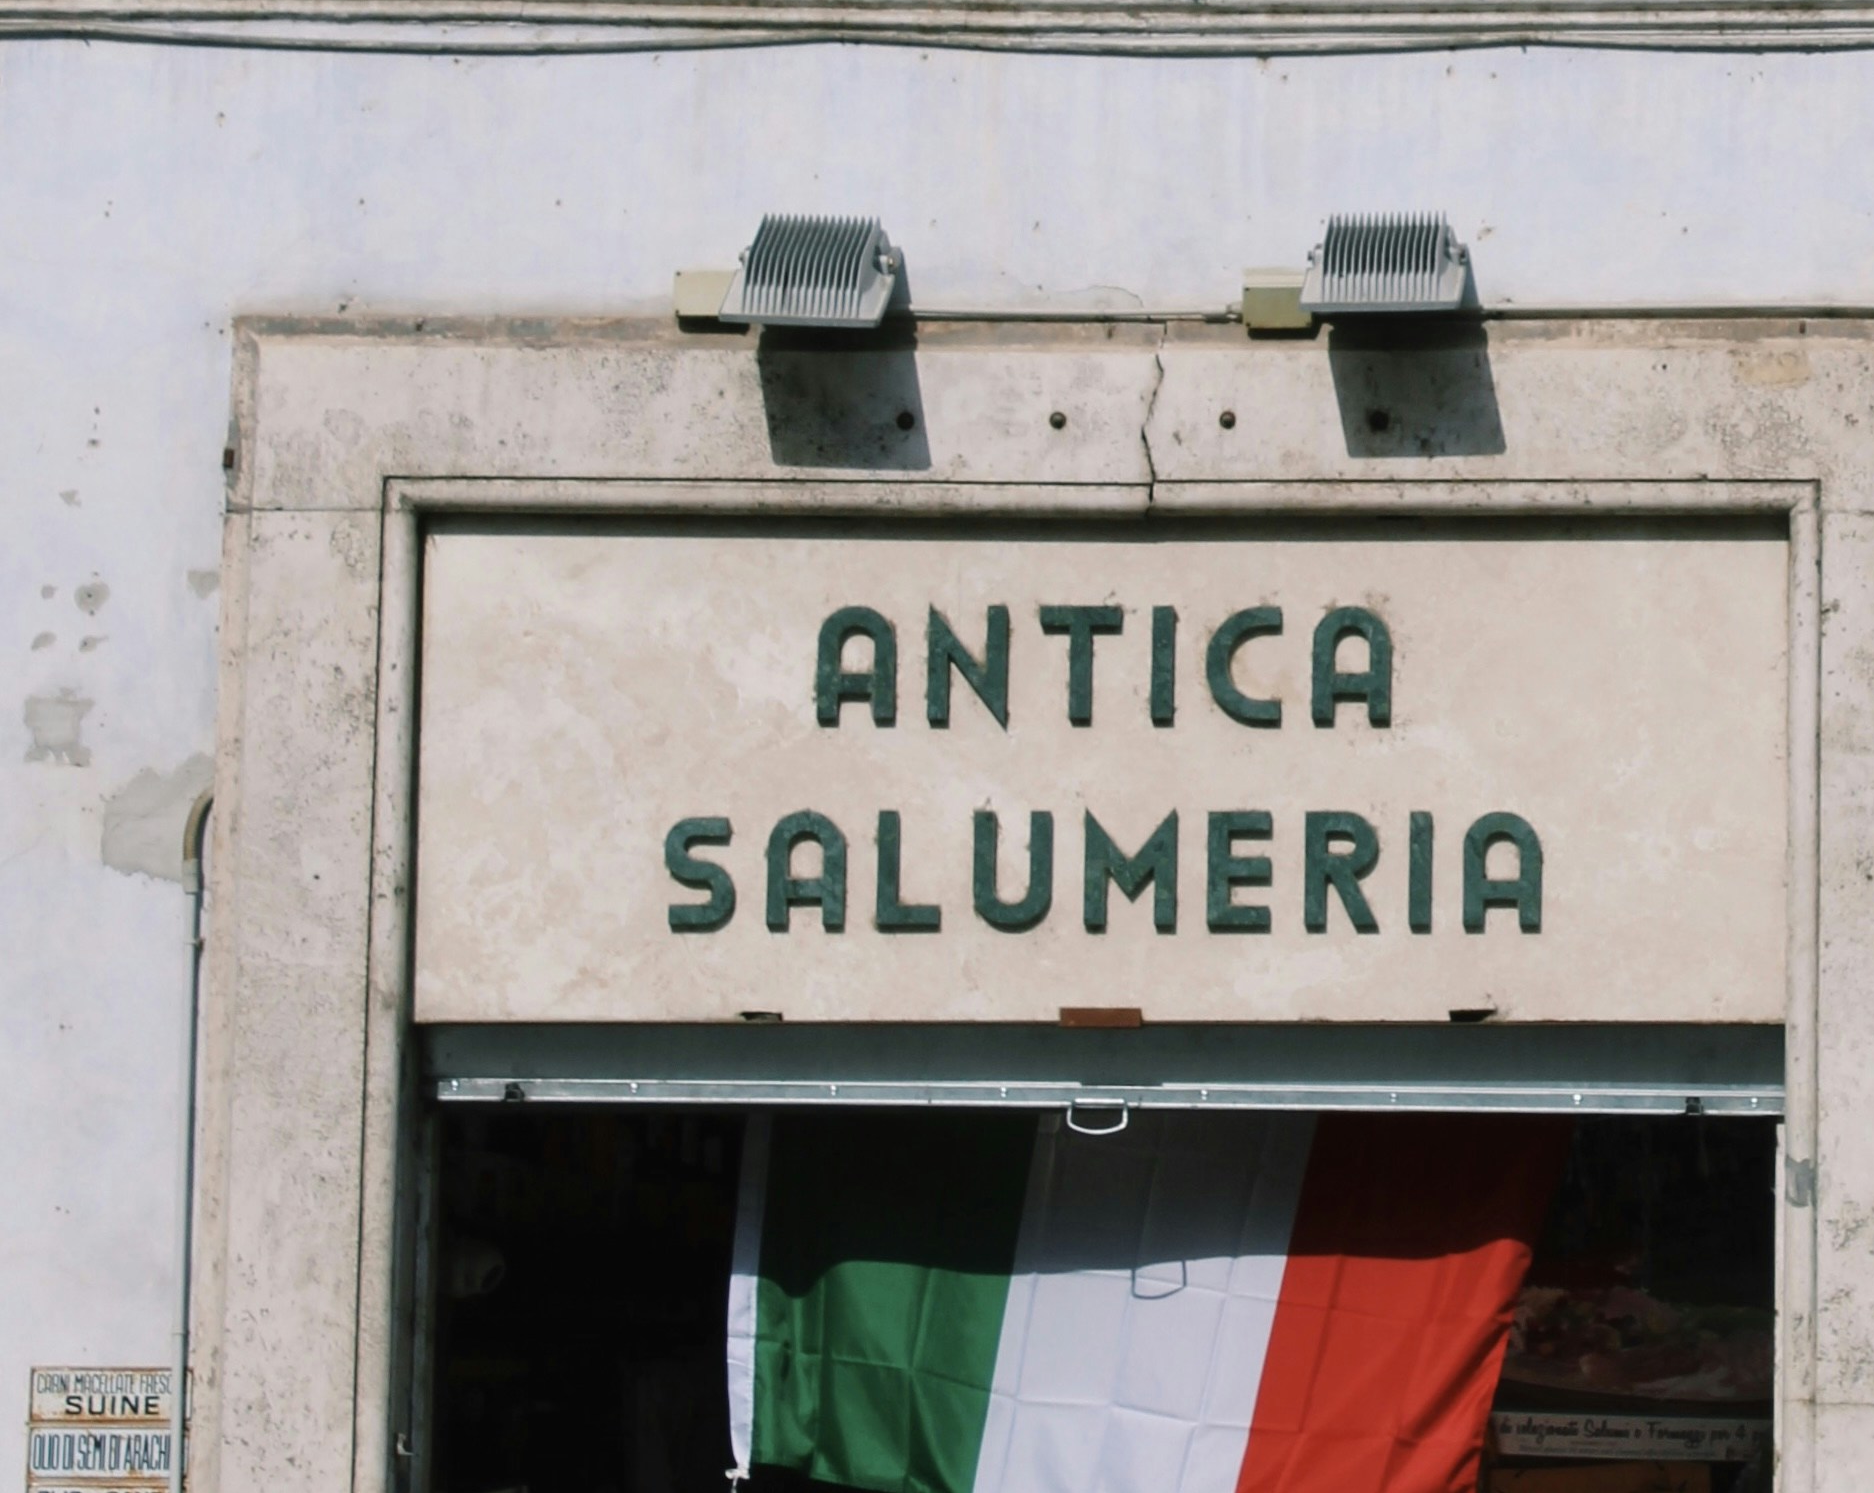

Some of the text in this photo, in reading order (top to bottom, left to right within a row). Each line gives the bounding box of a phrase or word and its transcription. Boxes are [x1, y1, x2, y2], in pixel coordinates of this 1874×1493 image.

[814, 604, 1395, 729] ANTICA
[664, 807, 1544, 935] SALUMERIA
[36, 1373, 172, 1395] CARNI MACELLATE FRESC
[65, 1395, 161, 1415] SUINE
[33, 1433, 61, 1471] OLIO
[61, 1434, 76, 1471] DI
[77, 1434, 107, 1472] SEMI
[123, 1434, 171, 1471] ARACHI
